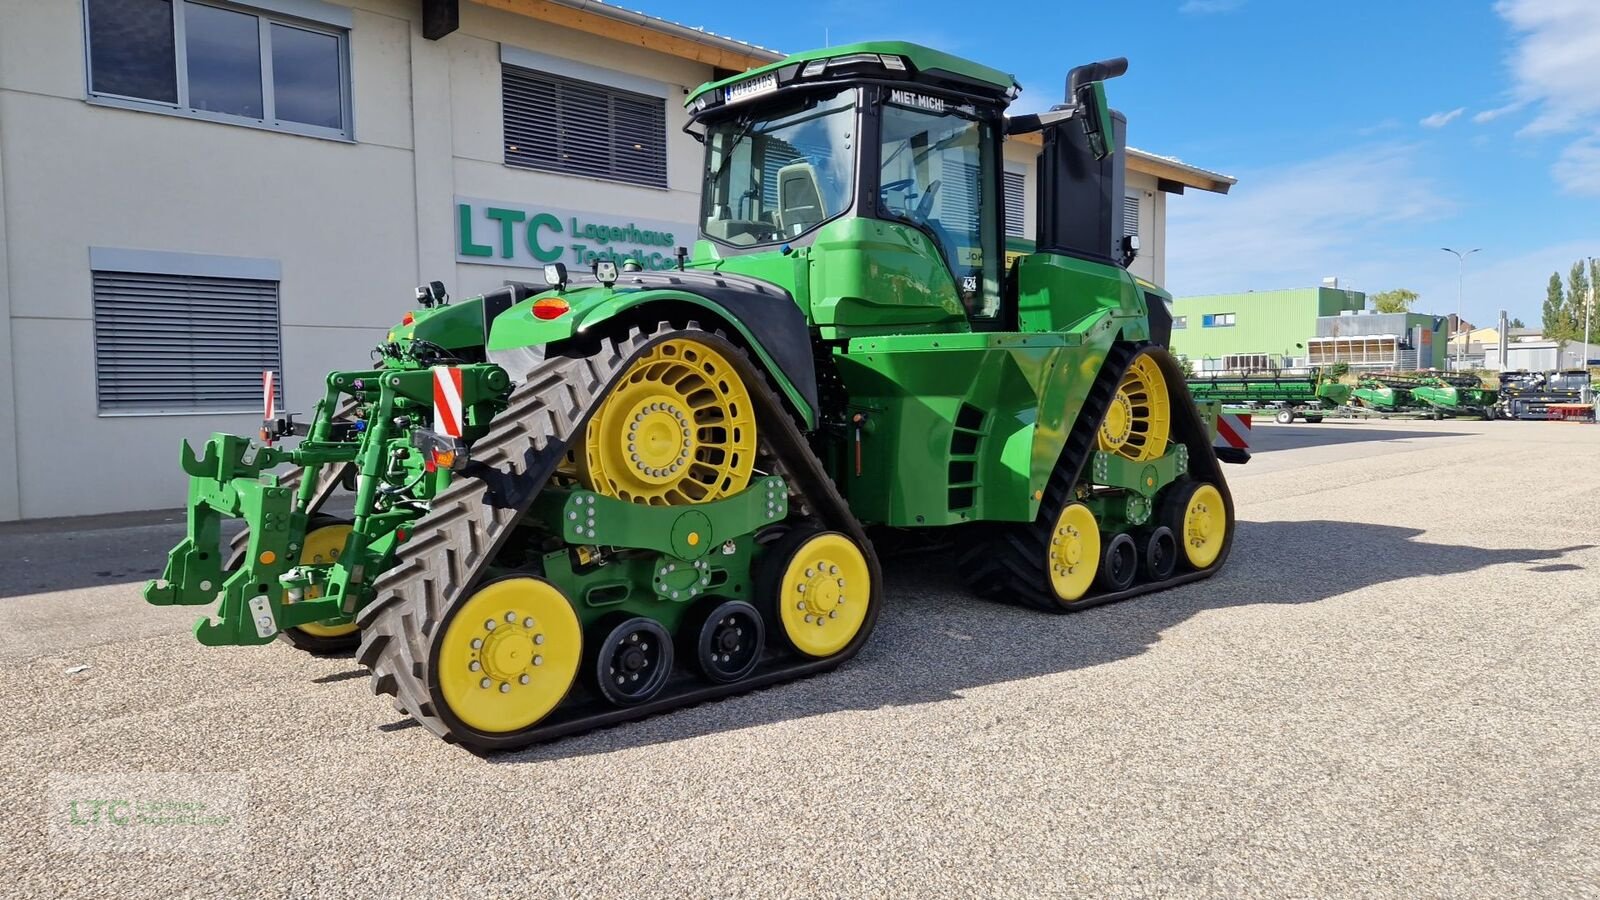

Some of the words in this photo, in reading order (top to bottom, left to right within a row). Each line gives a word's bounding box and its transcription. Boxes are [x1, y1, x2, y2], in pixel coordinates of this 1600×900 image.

[891, 89, 916, 105] MIET
[917, 94, 944, 111] MICH!
[459, 203, 564, 263] LTC
[570, 216, 674, 247] Lagerhaus
